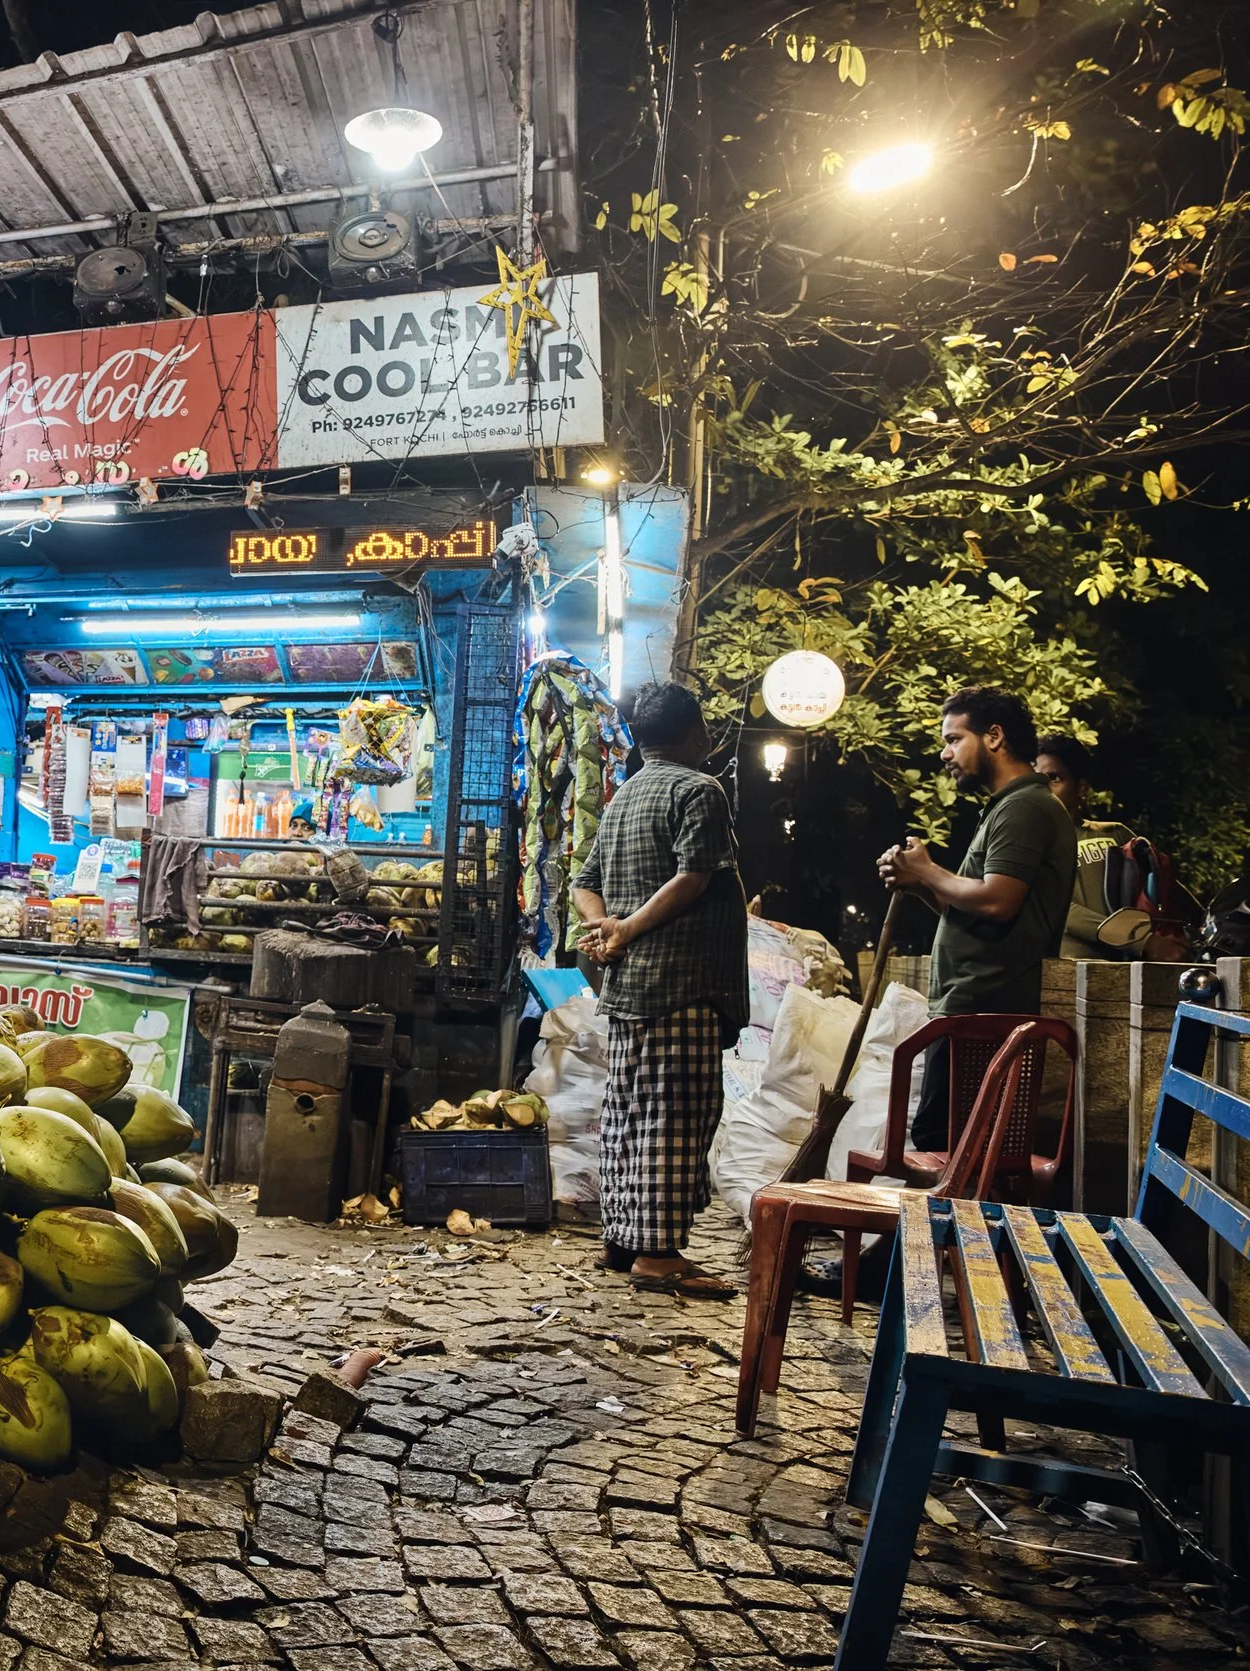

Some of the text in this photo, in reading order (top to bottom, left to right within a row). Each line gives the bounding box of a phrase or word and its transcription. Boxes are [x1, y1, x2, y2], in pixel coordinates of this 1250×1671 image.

[298, 343, 585, 406] COOL BAR
[312, 419, 337, 433] Ph:
[26, 439, 132, 464] Real Magic
[371, 437, 401, 449] FORT
